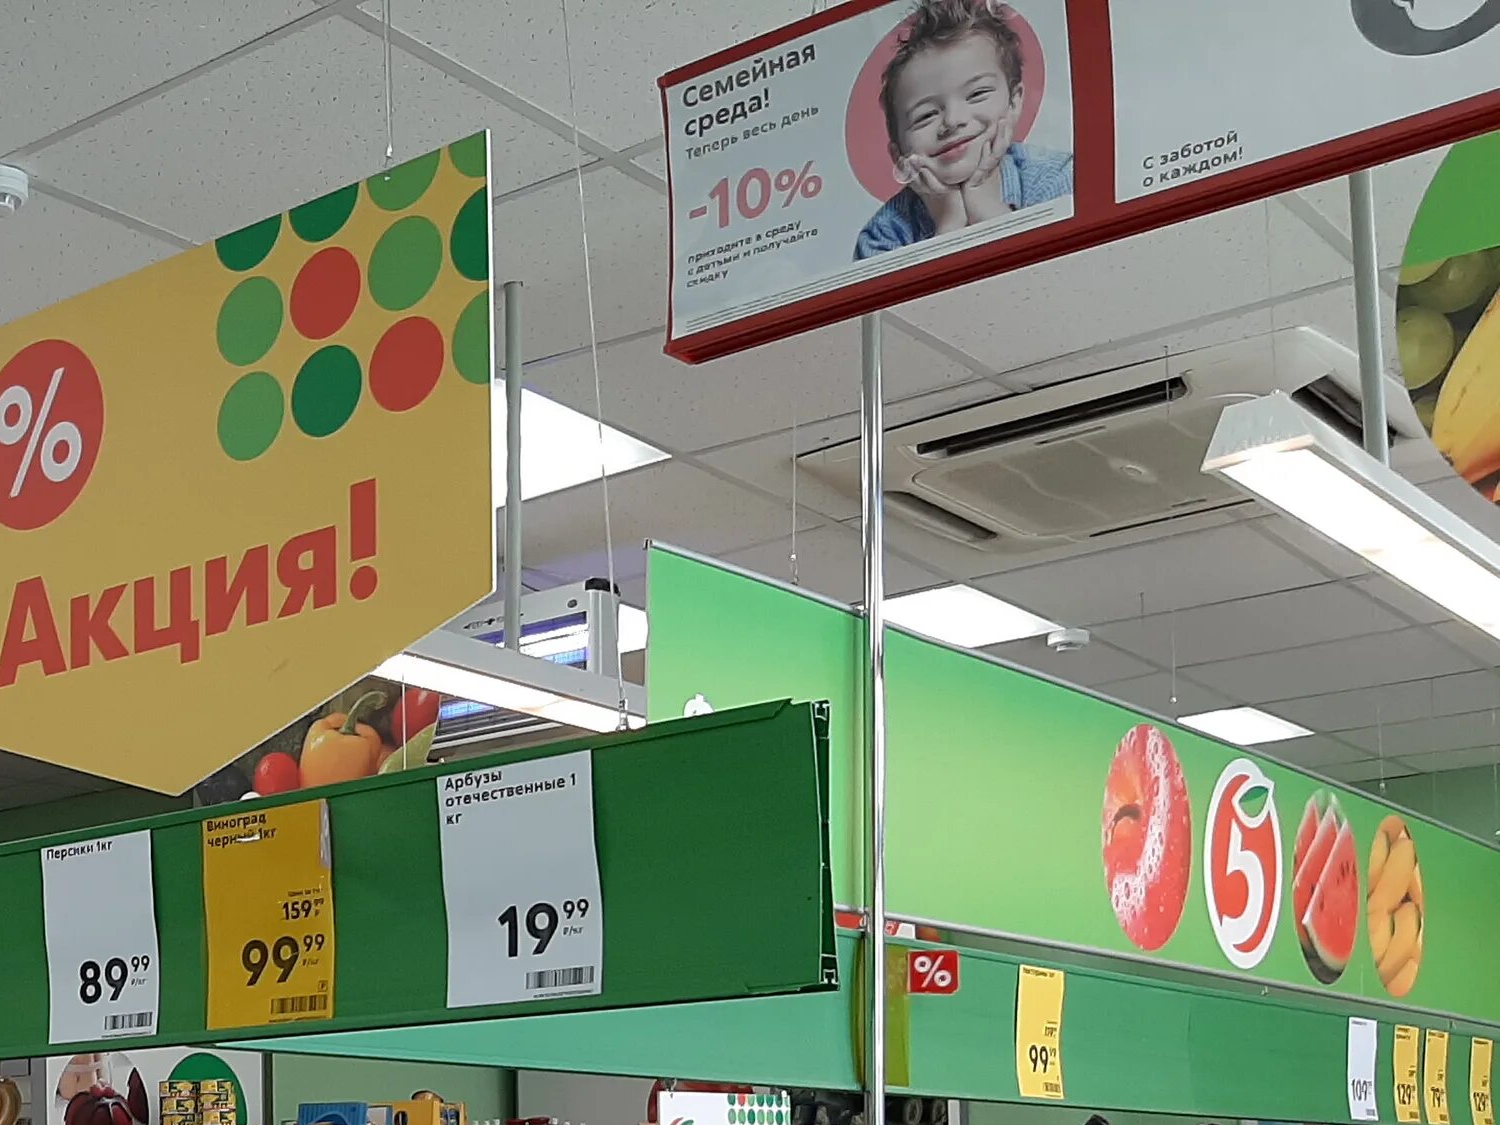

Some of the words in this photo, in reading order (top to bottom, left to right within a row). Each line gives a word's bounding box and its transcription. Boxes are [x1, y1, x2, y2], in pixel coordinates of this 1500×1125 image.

[683, 44, 815, 107] Семейная
[685, 88, 769, 137] среда!
[686, 135, 738, 159] Теперь
[743, 121, 776, 139] весь
[781, 106, 818, 127] день
[1143, 157, 1153, 169] С
[1160, 131, 1237, 165] заботой
[1143, 177, 1153, 186] о
[1160, 147, 1242, 182] каждом!
[689, 160, 822, 228] -10%
[766, 220, 801, 237] среду
[445, 771, 501, 791] Арбузы
[446, 776, 565, 807] отечественные
[569, 773, 576, 786] 1
[207, 813, 266, 832] Виноград
[446, 813, 462, 824] кг
[46, 844, 94, 860] Персики
[96, 840, 112, 851] 1кг
[282, 900, 312, 920] 159
[498, 903, 558, 958] 19
[563, 899, 589, 919] 99
[242, 936, 300, 986] 99
[303, 934, 324, 951] 99
[79, 958, 128, 1004] 89
[131, 956, 150, 971] 99
[1029, 1045, 1048, 1073] 99
[1351, 1079, 1367, 1101] 109
[1397, 1084, 1411, 1105] 129
